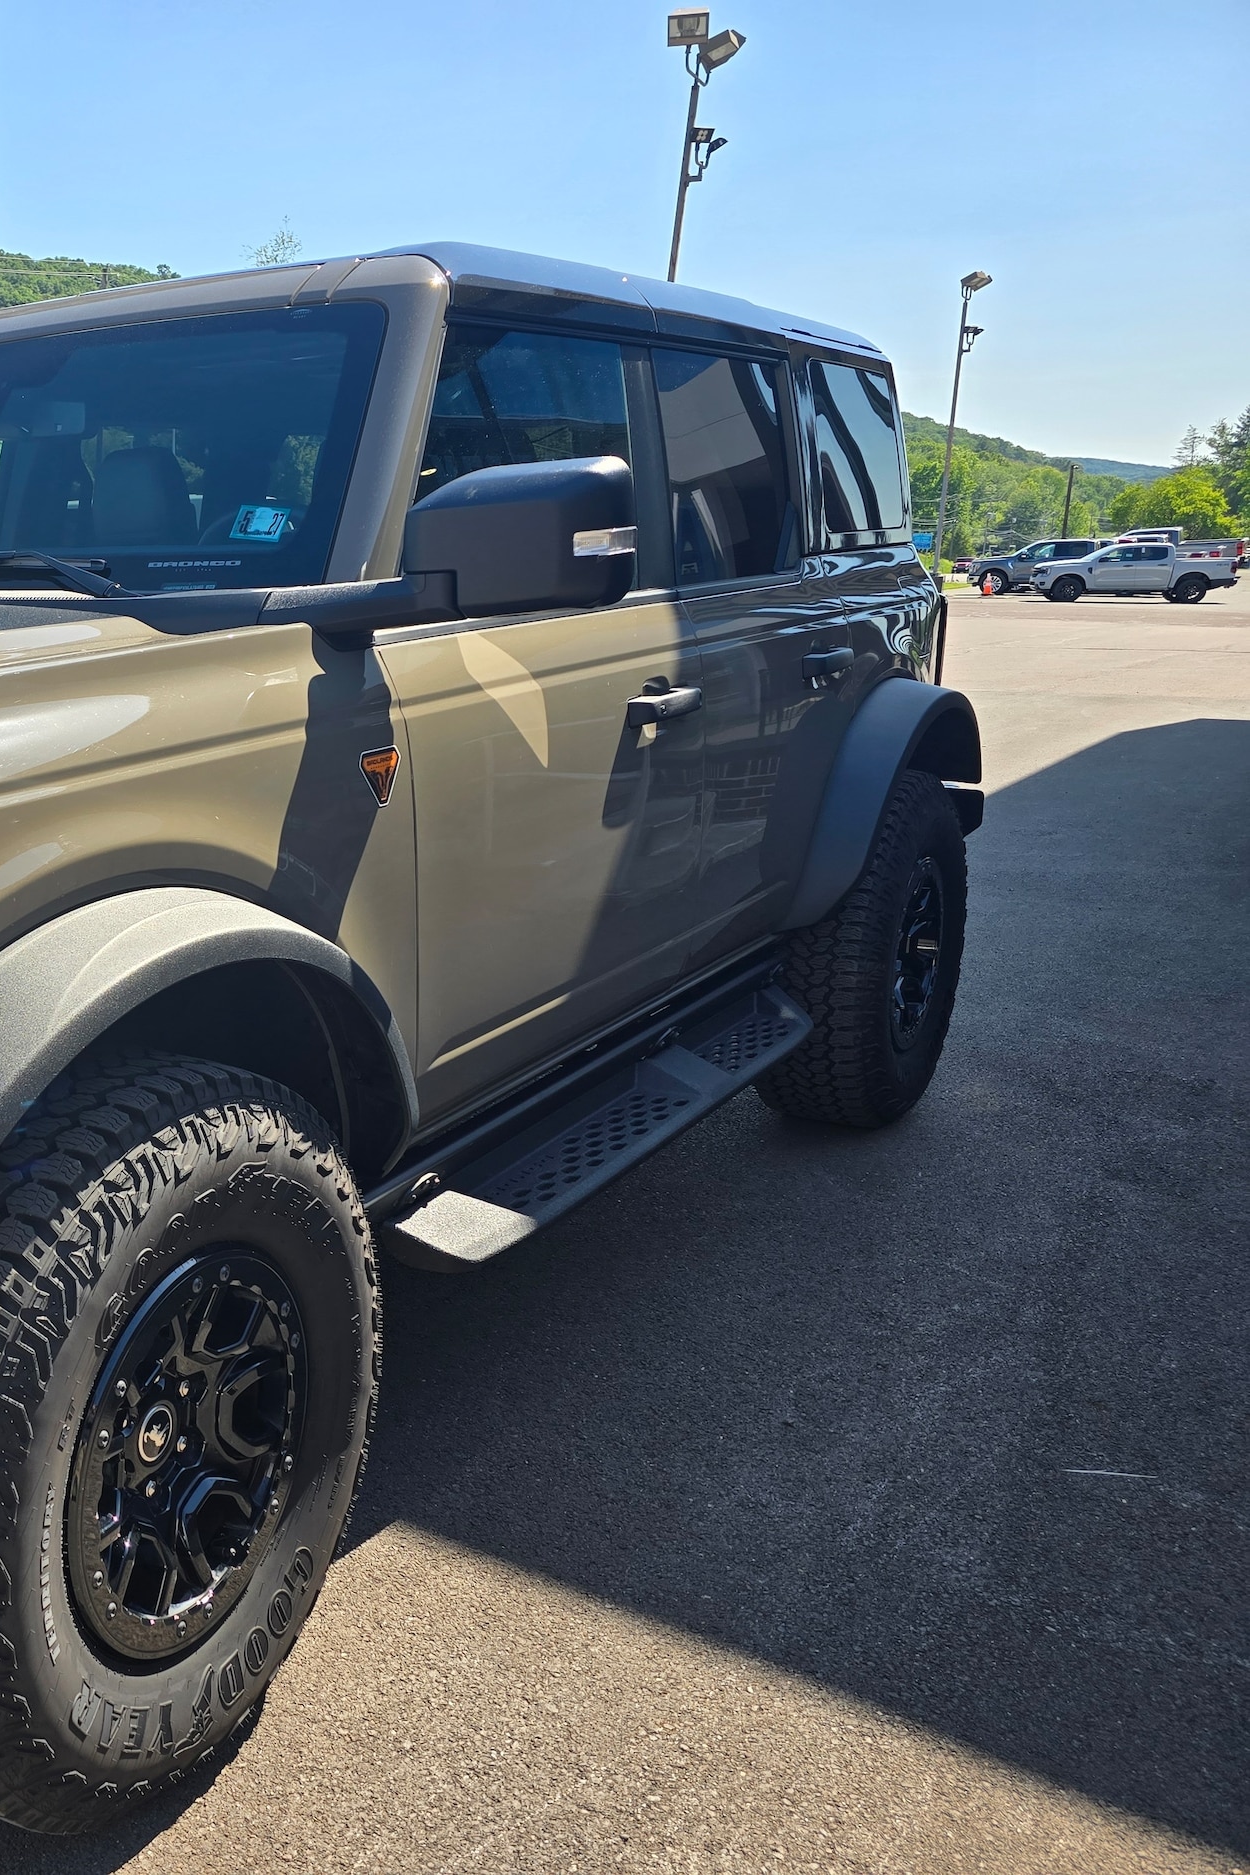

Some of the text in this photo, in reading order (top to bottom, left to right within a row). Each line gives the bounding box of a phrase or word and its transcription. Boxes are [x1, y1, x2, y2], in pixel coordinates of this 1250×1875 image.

[268, 512, 285, 536] 27
[148, 560, 241, 568] BRONCO
[40, 1481, 60, 1666] TERRITORY
